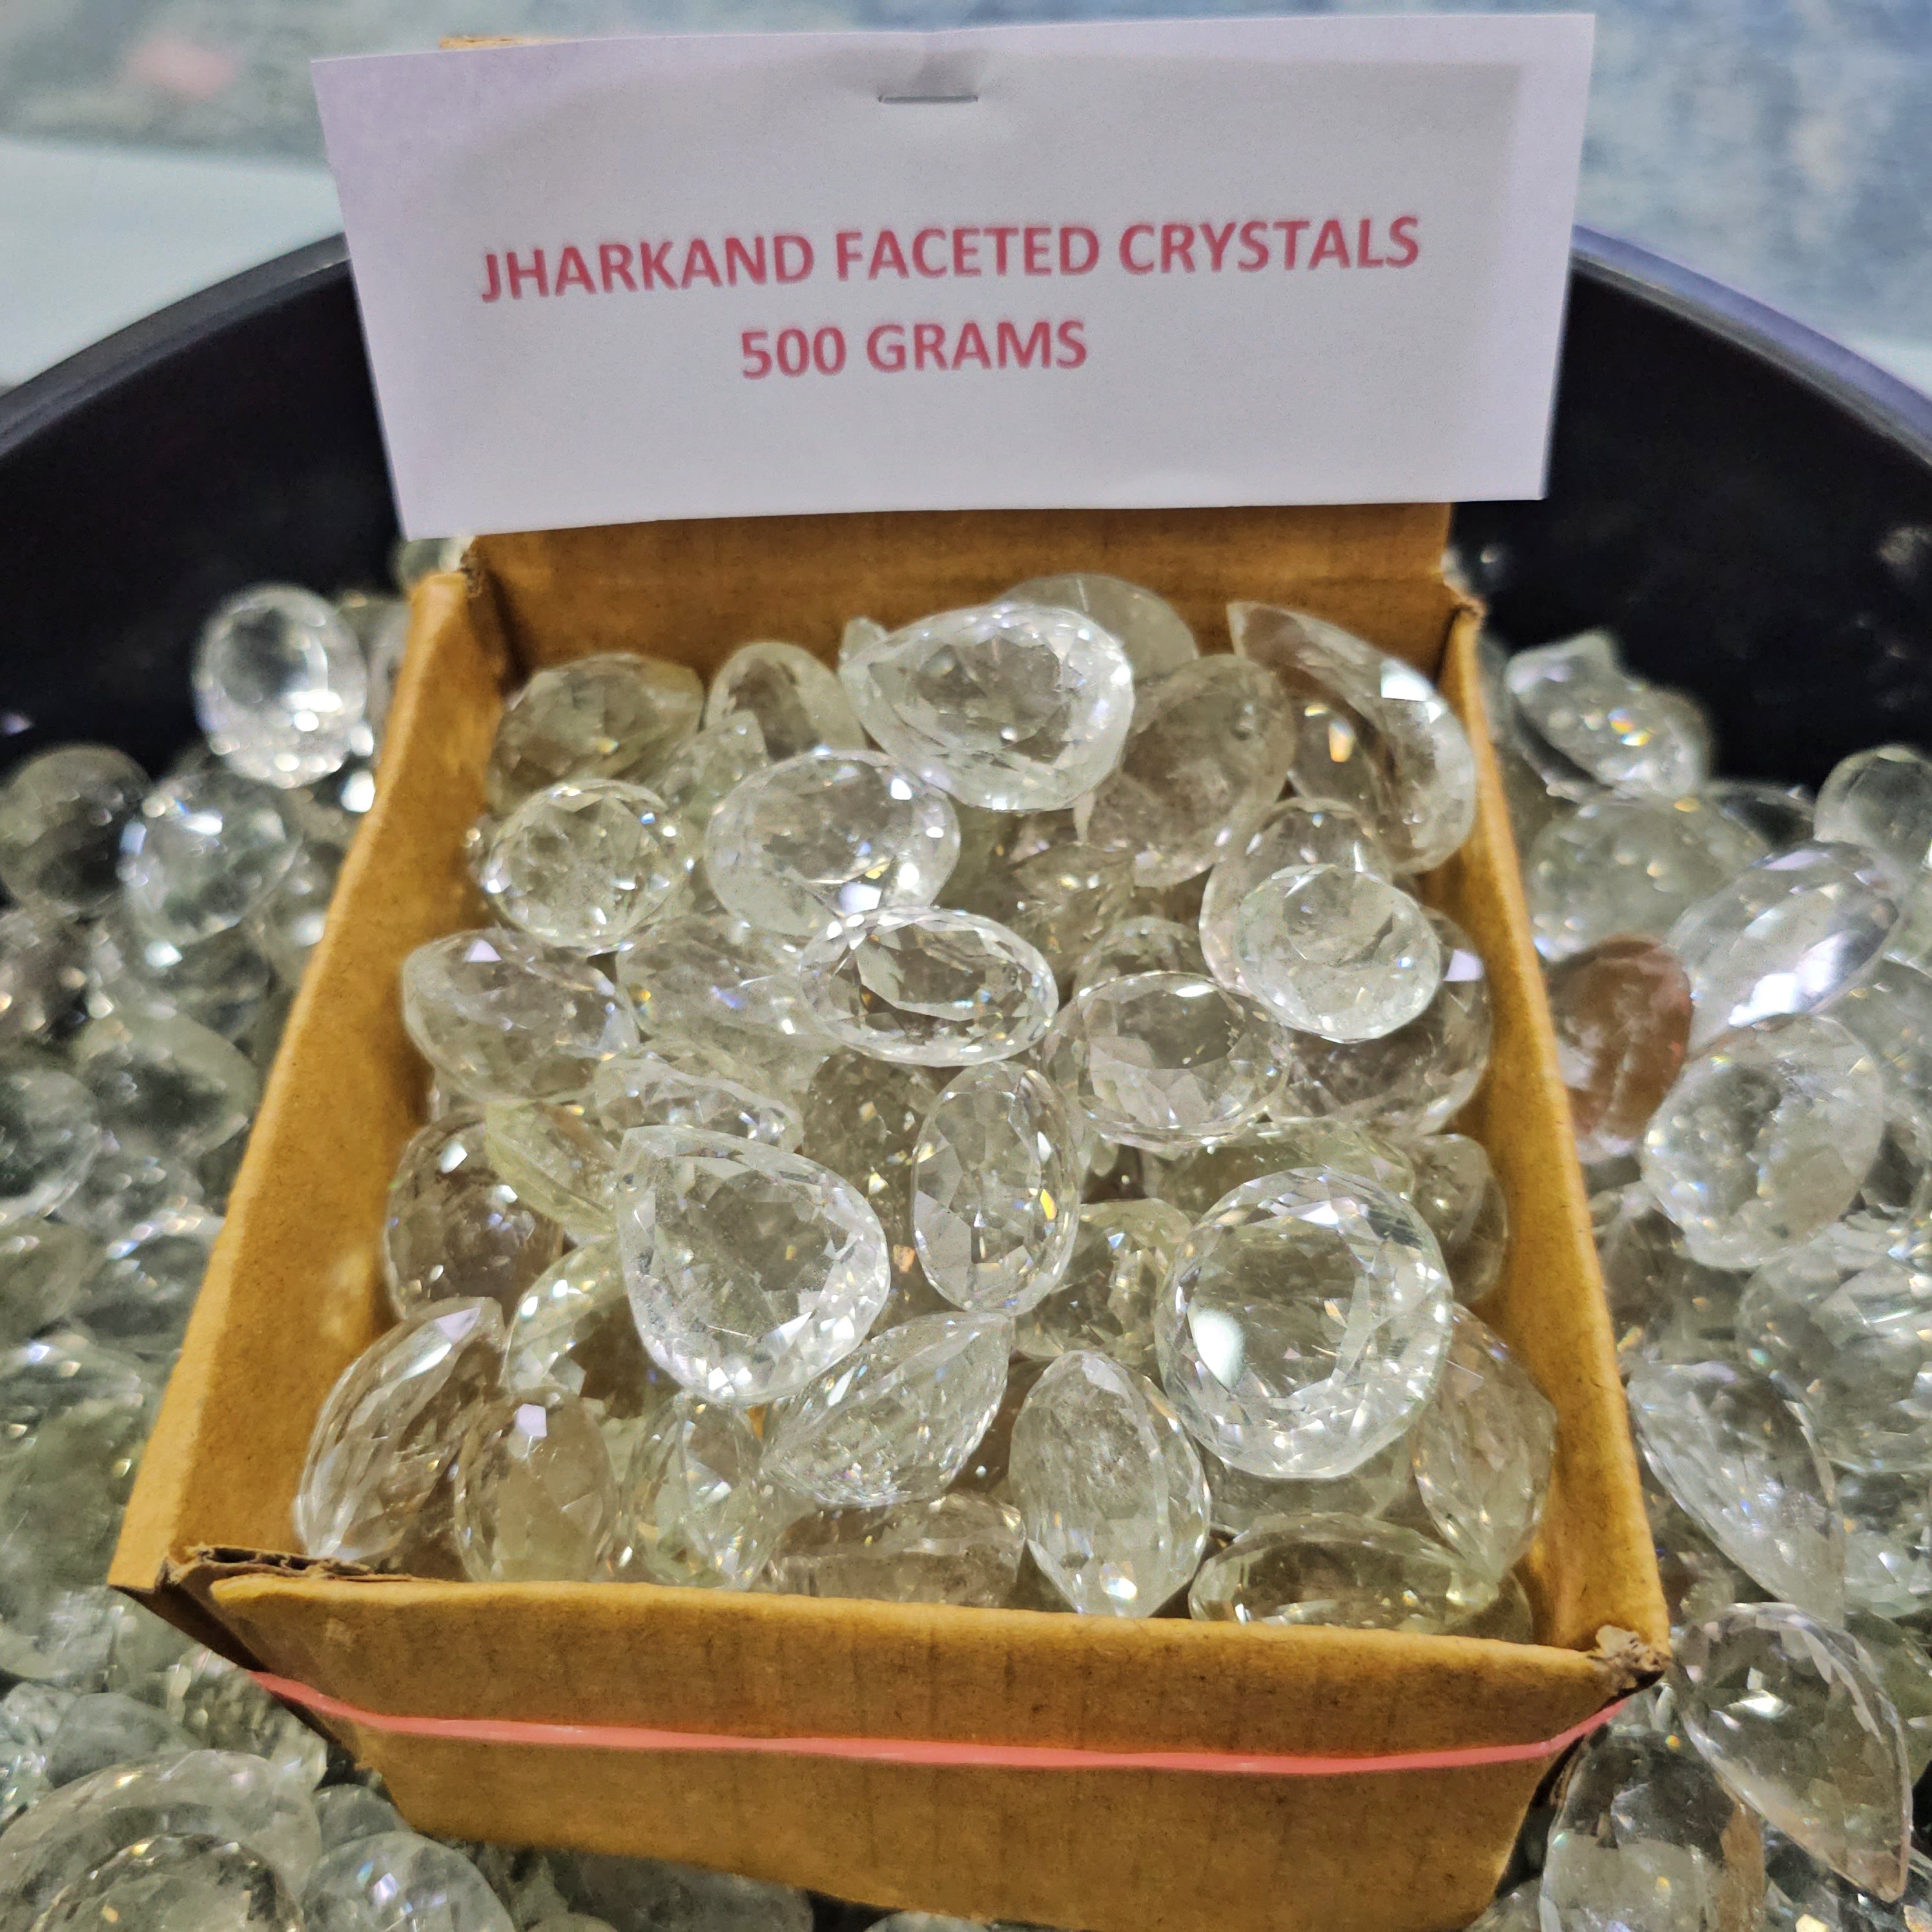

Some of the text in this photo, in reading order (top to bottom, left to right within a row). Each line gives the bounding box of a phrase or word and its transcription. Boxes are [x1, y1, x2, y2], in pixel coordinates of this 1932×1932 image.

[481, 216, 1420, 302] JHARKAND FACETED CRYSTALS
[740, 319, 1088, 379] 500 GRAMS
